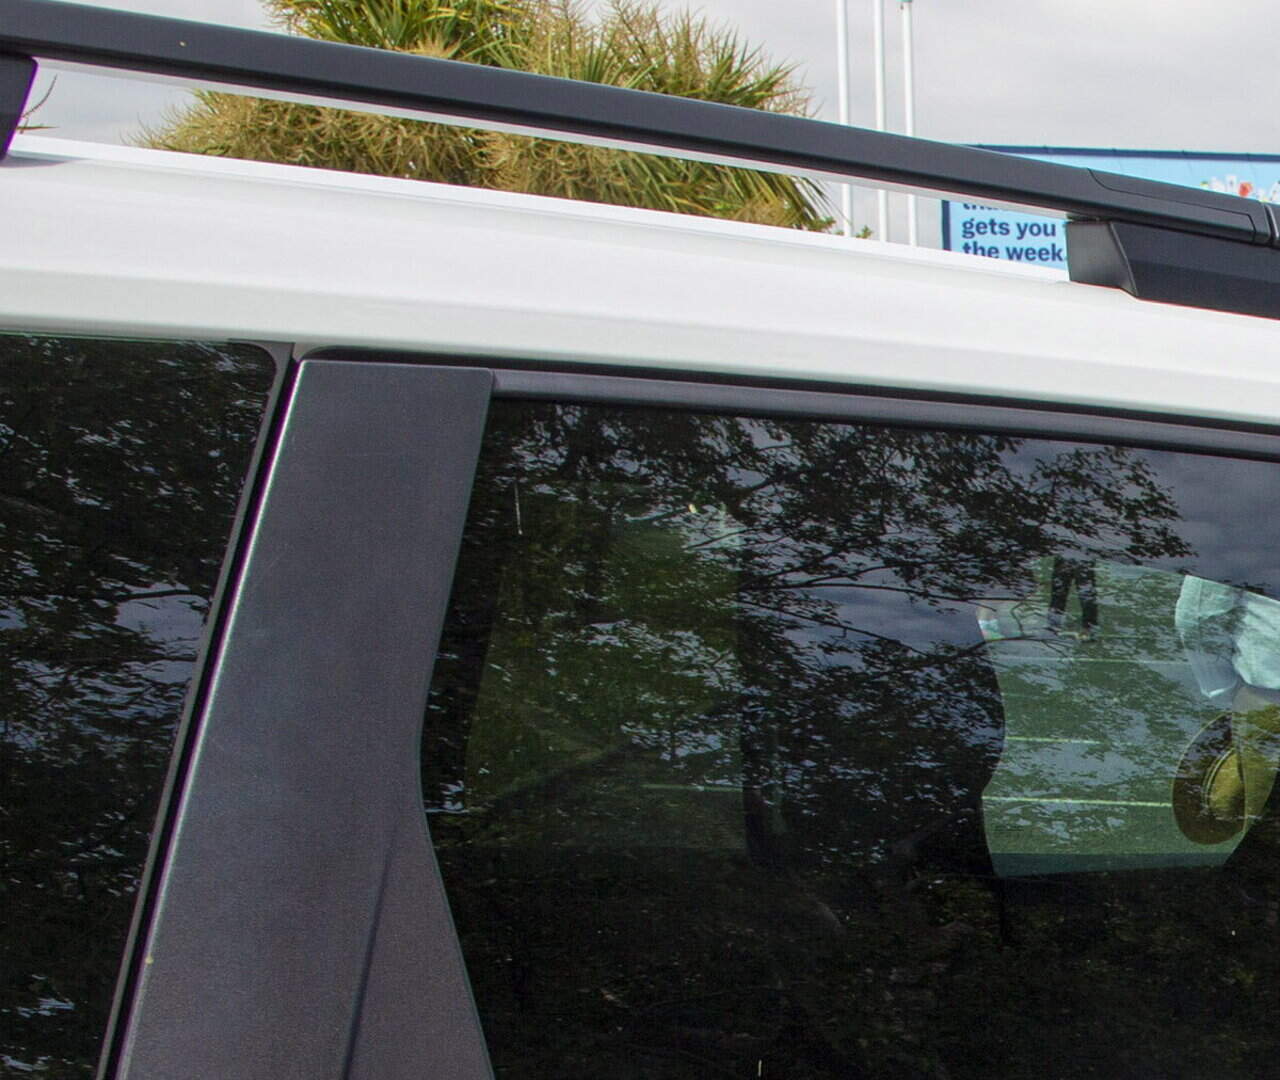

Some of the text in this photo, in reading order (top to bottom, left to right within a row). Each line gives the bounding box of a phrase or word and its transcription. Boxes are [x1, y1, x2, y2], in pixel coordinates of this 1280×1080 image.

[962, 218, 1056, 240] gets you
[962, 241, 1063, 261] the week
